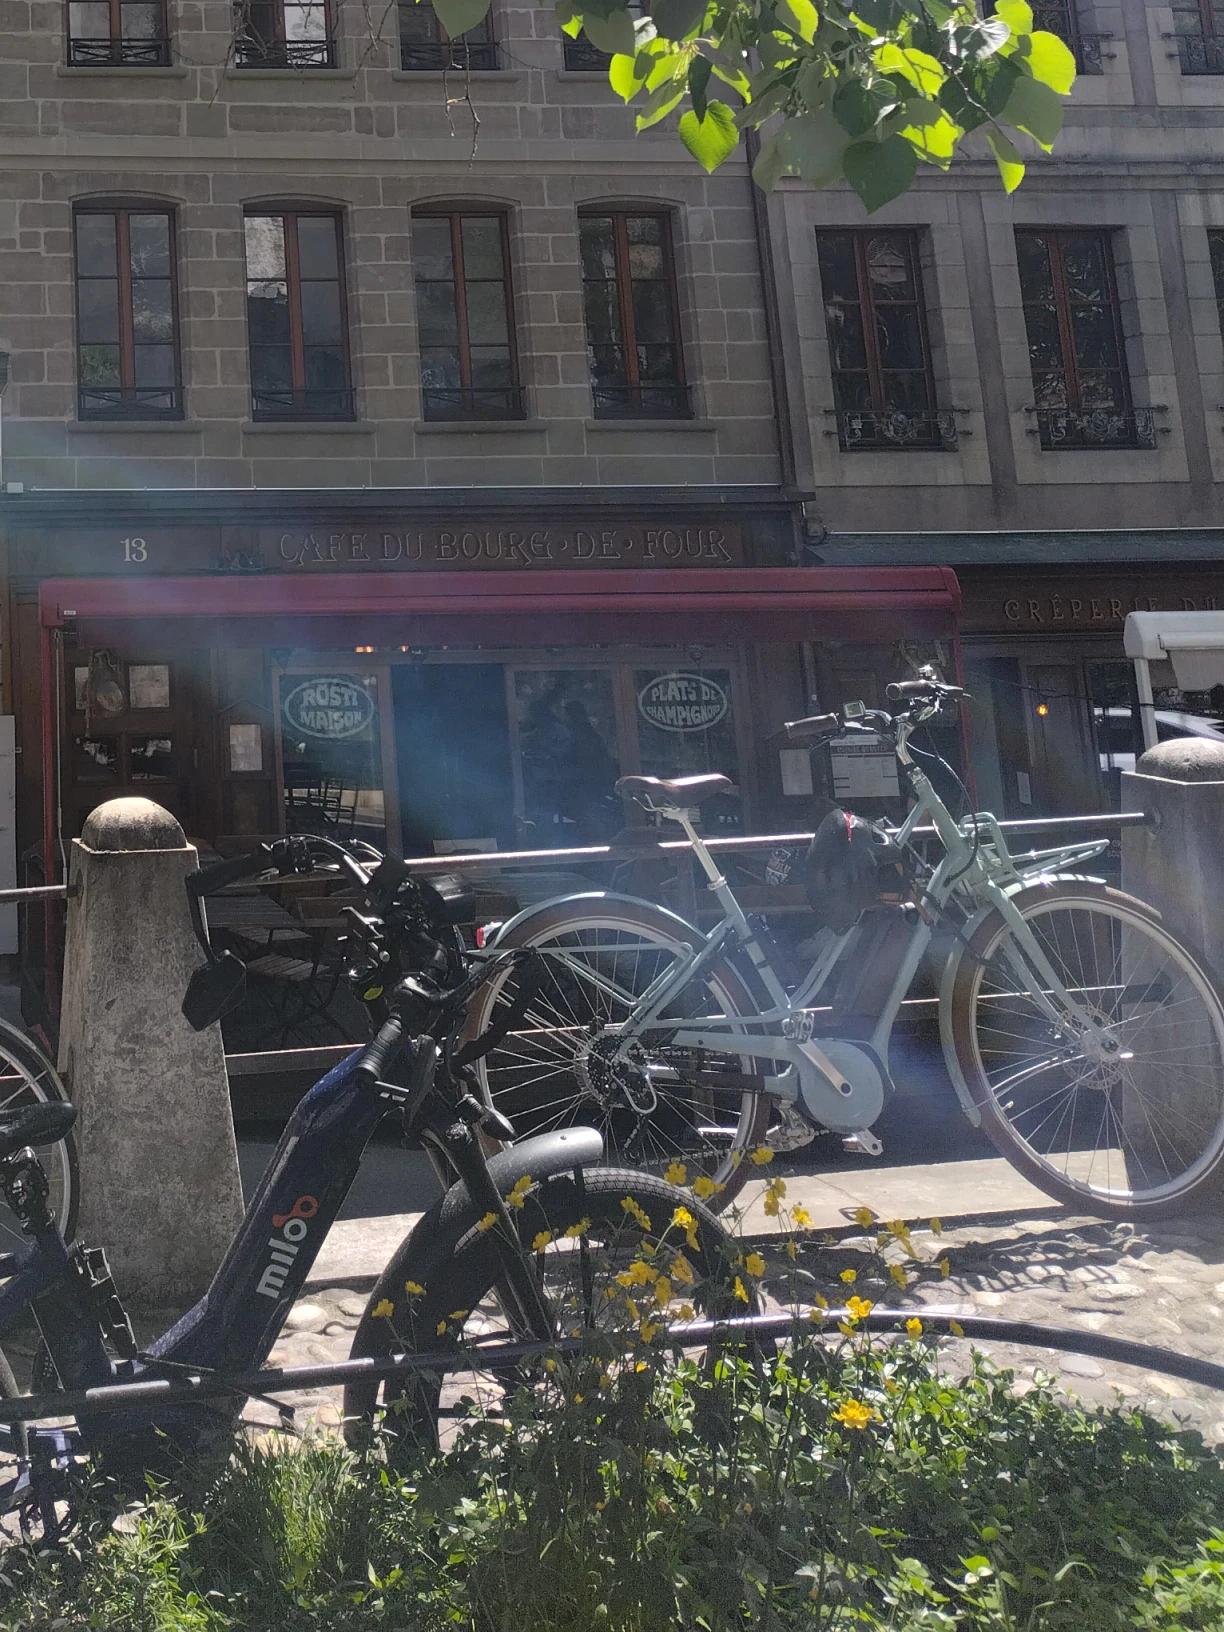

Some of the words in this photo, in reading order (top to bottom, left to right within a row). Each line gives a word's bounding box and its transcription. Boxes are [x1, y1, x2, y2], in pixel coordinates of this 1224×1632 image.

[120, 537, 148, 562] 13
[378, 532, 424, 561] DU
[434, 531, 553, 566] BOURG
[572, 530, 622, 559] DE
[642, 530, 732, 563] FOUR
[651, 680, 697, 702] PLATS
[700, 682, 717, 701] DE
[300, 710, 362, 731] MAISON
